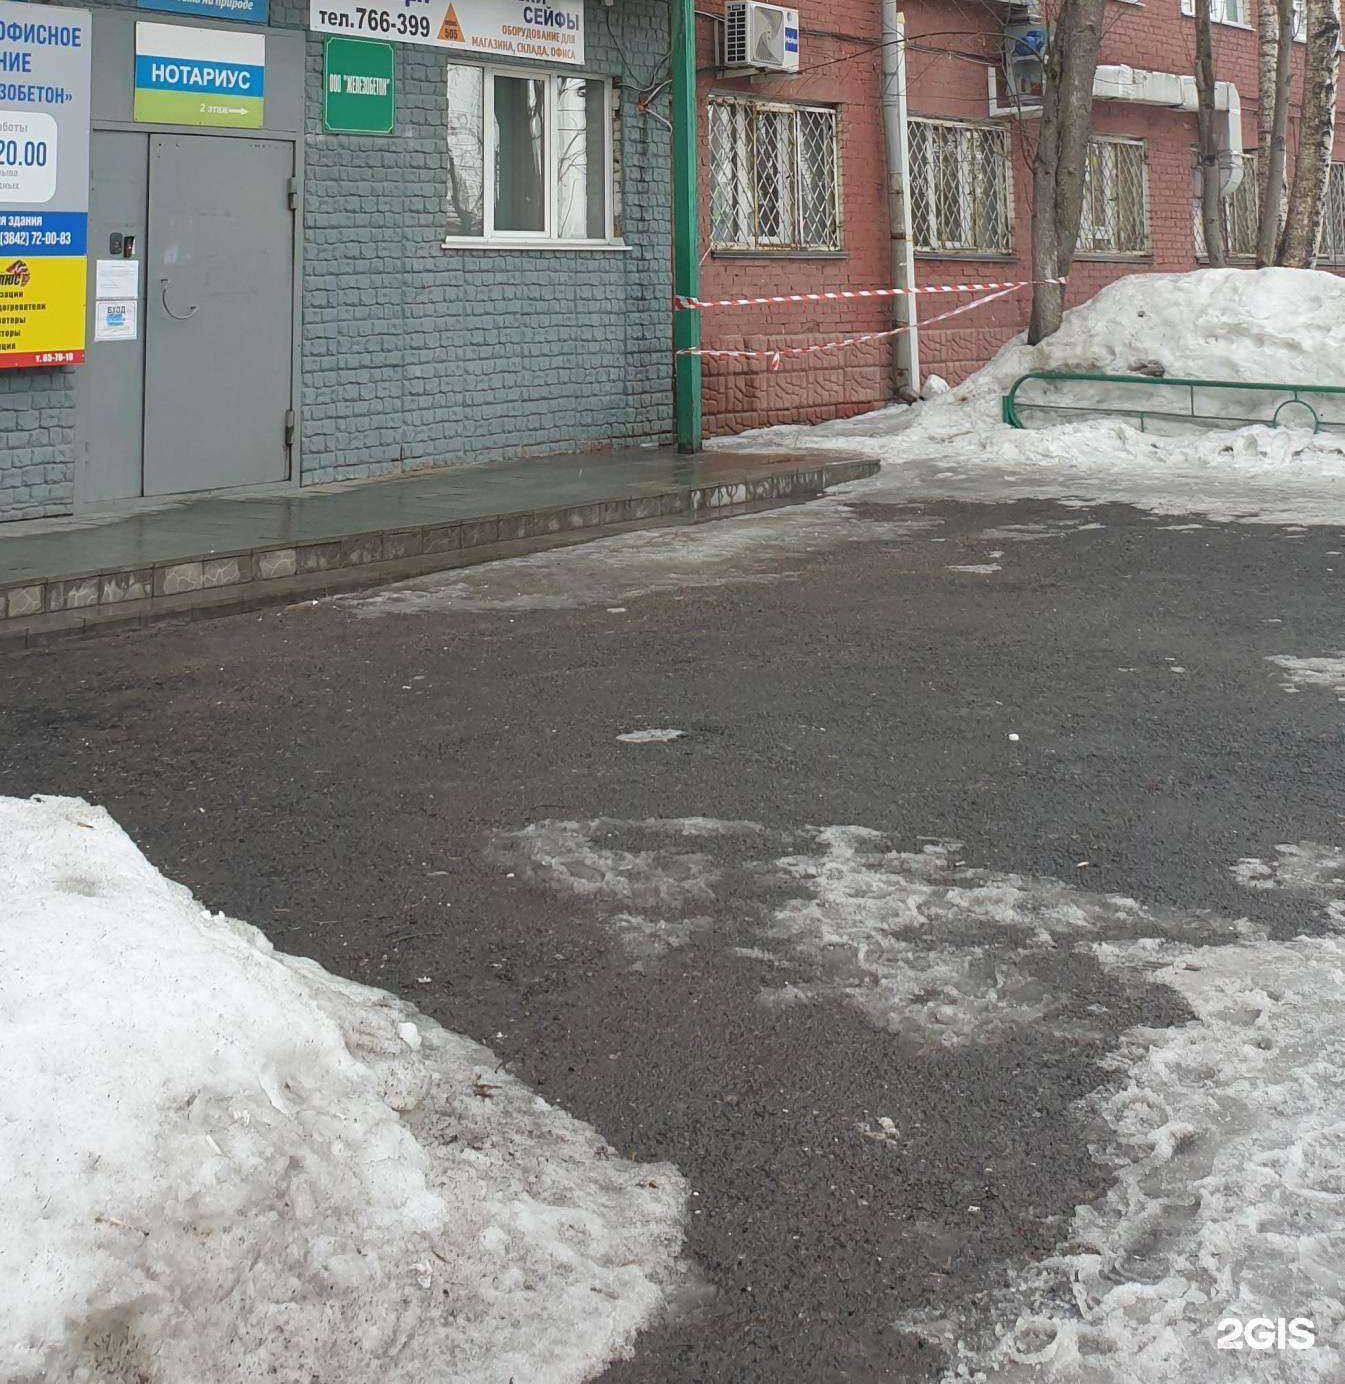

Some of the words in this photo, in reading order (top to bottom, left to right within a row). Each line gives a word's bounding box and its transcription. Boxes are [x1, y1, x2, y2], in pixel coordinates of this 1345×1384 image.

[523, 6, 579, 31] СЕЙФЫ
[444, 29, 458, 40] 505
[501, 24, 560, 43] ОБОРУДОВАНИЕ
[560, 34, 576, 45] ДЛЯ
[471, 36, 515, 54] МАГАЗИНА,
[516, 42, 549, 57] СКЛАДА,
[550, 46, 576, 60] ОФИСА
[152, 63, 251, 90] НОТАРИУС
[329, 73, 342, 93] ООО
[343, 74, 391, 96] "ЖЕЛЕЗОБЕТОН"
[199, 103, 206, 113] 2
[207, 105, 230, 114] этаж
[8, 216, 43, 228] здания
[0, 232, 29, 246] (3842)
[31, 232, 72, 245] 72-00-83
